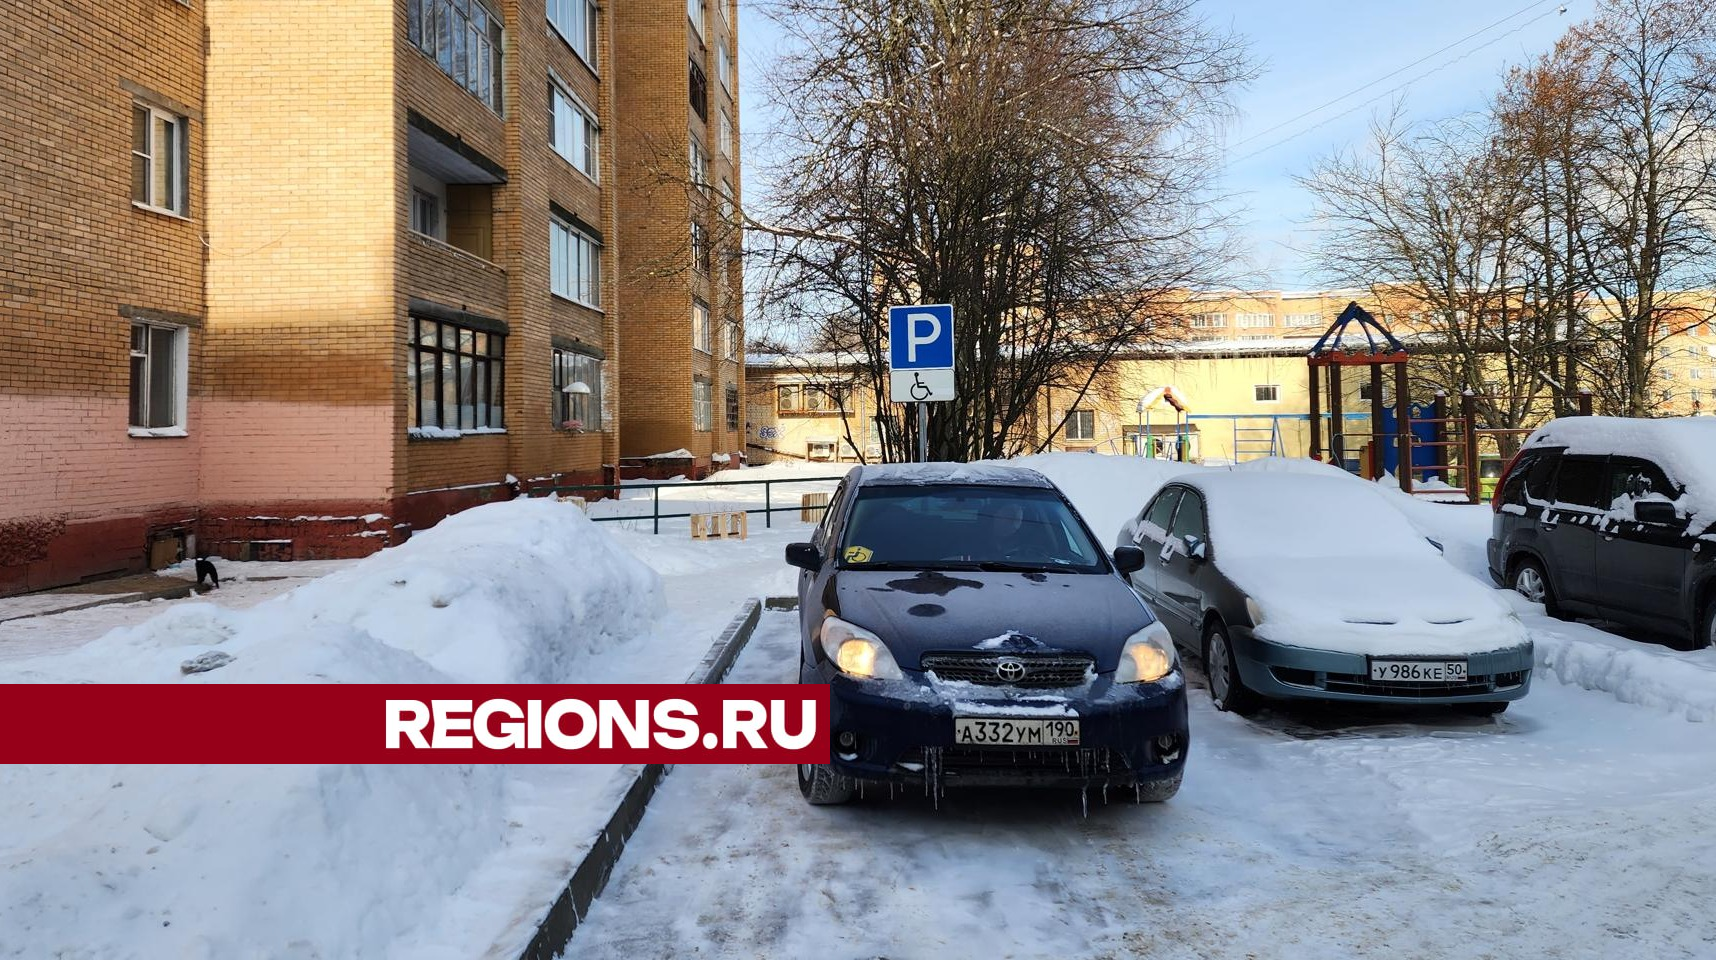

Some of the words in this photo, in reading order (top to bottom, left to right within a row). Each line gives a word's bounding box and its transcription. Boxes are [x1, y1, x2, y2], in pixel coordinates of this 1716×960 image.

[908, 313, 941, 362] P
[1447, 664, 1462, 675] 50
[1045, 721, 1075, 737] 190
